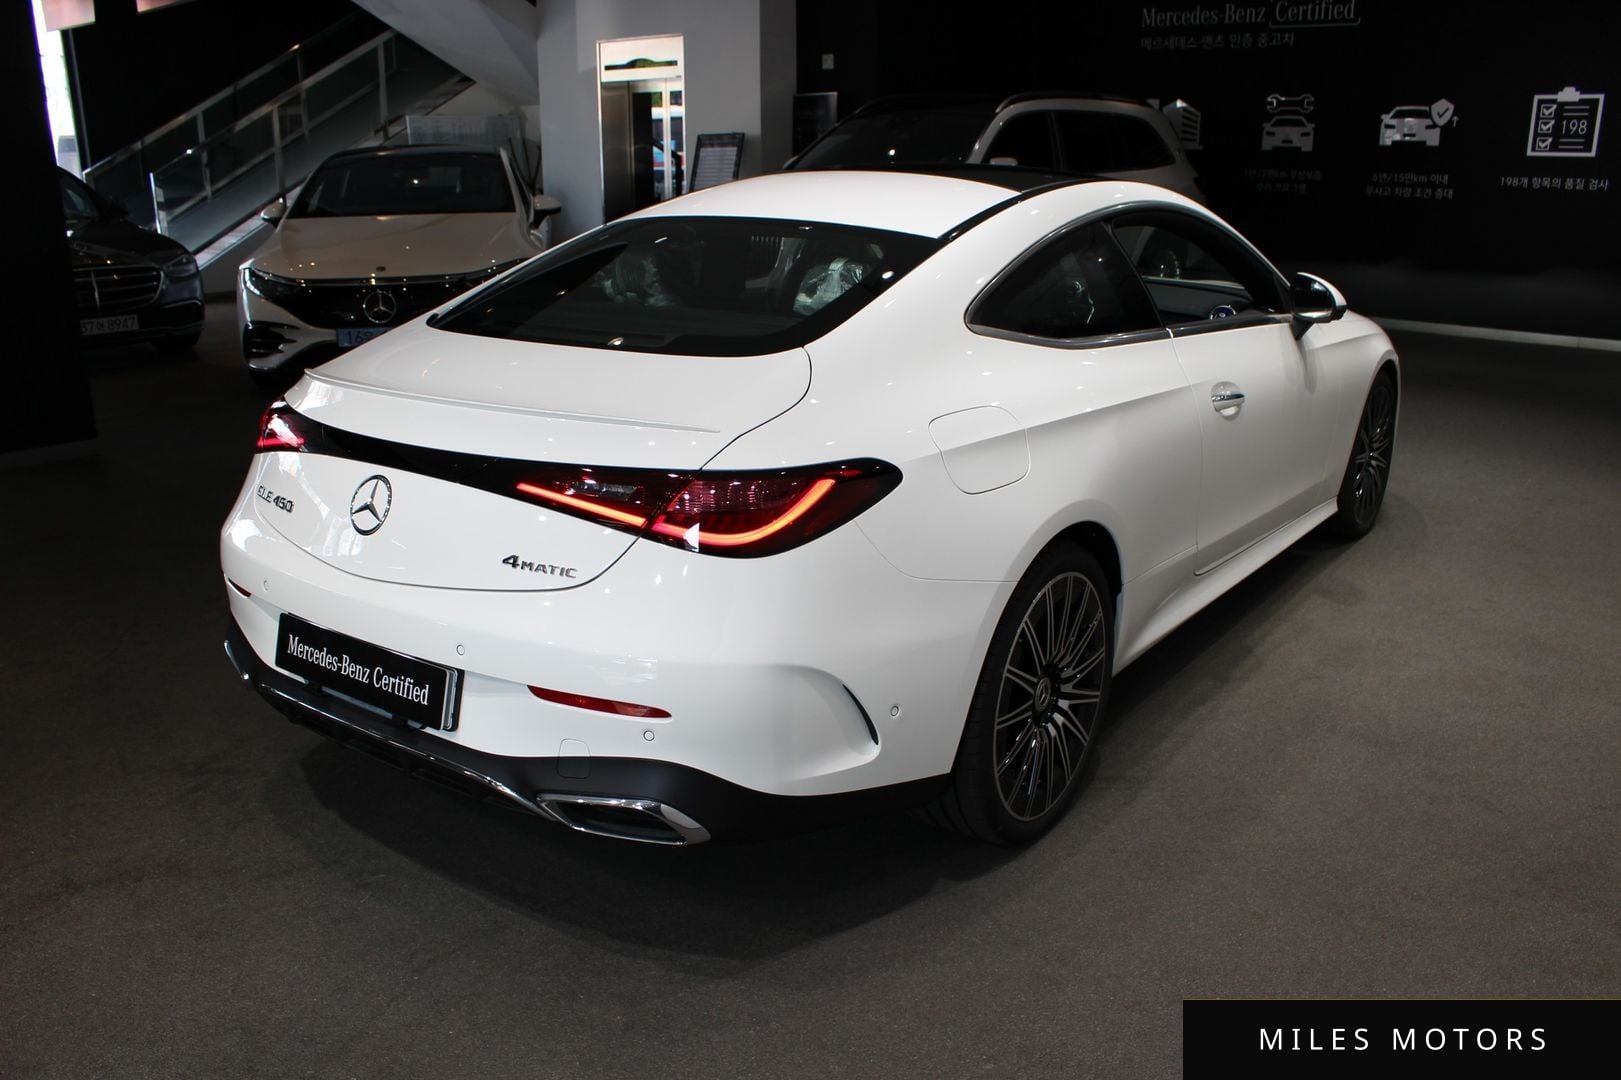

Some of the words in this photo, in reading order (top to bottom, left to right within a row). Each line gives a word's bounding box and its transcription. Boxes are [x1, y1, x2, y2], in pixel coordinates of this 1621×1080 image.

[1141, 3, 1266, 28] Mercedes-Benz
[1276, 0, 1356, 22] Certified
[1230, 33, 1253, 48] 인증
[1257, 32, 1295, 48] 중고차
[1561, 119, 1587, 135] 198
[1430, 173, 1449, 184] 이내
[1500, 176, 1529, 188] 198개
[1532, 176, 1561, 189] 항목의
[1565, 177, 1584, 190] 품질
[1589, 177, 1608, 190] 검사
[273, 495, 295, 513] 450
[502, 555, 578, 579] 4MATIC
[287, 633, 370, 684] Mercedes-Benz
[373, 666, 430, 706] Certified
